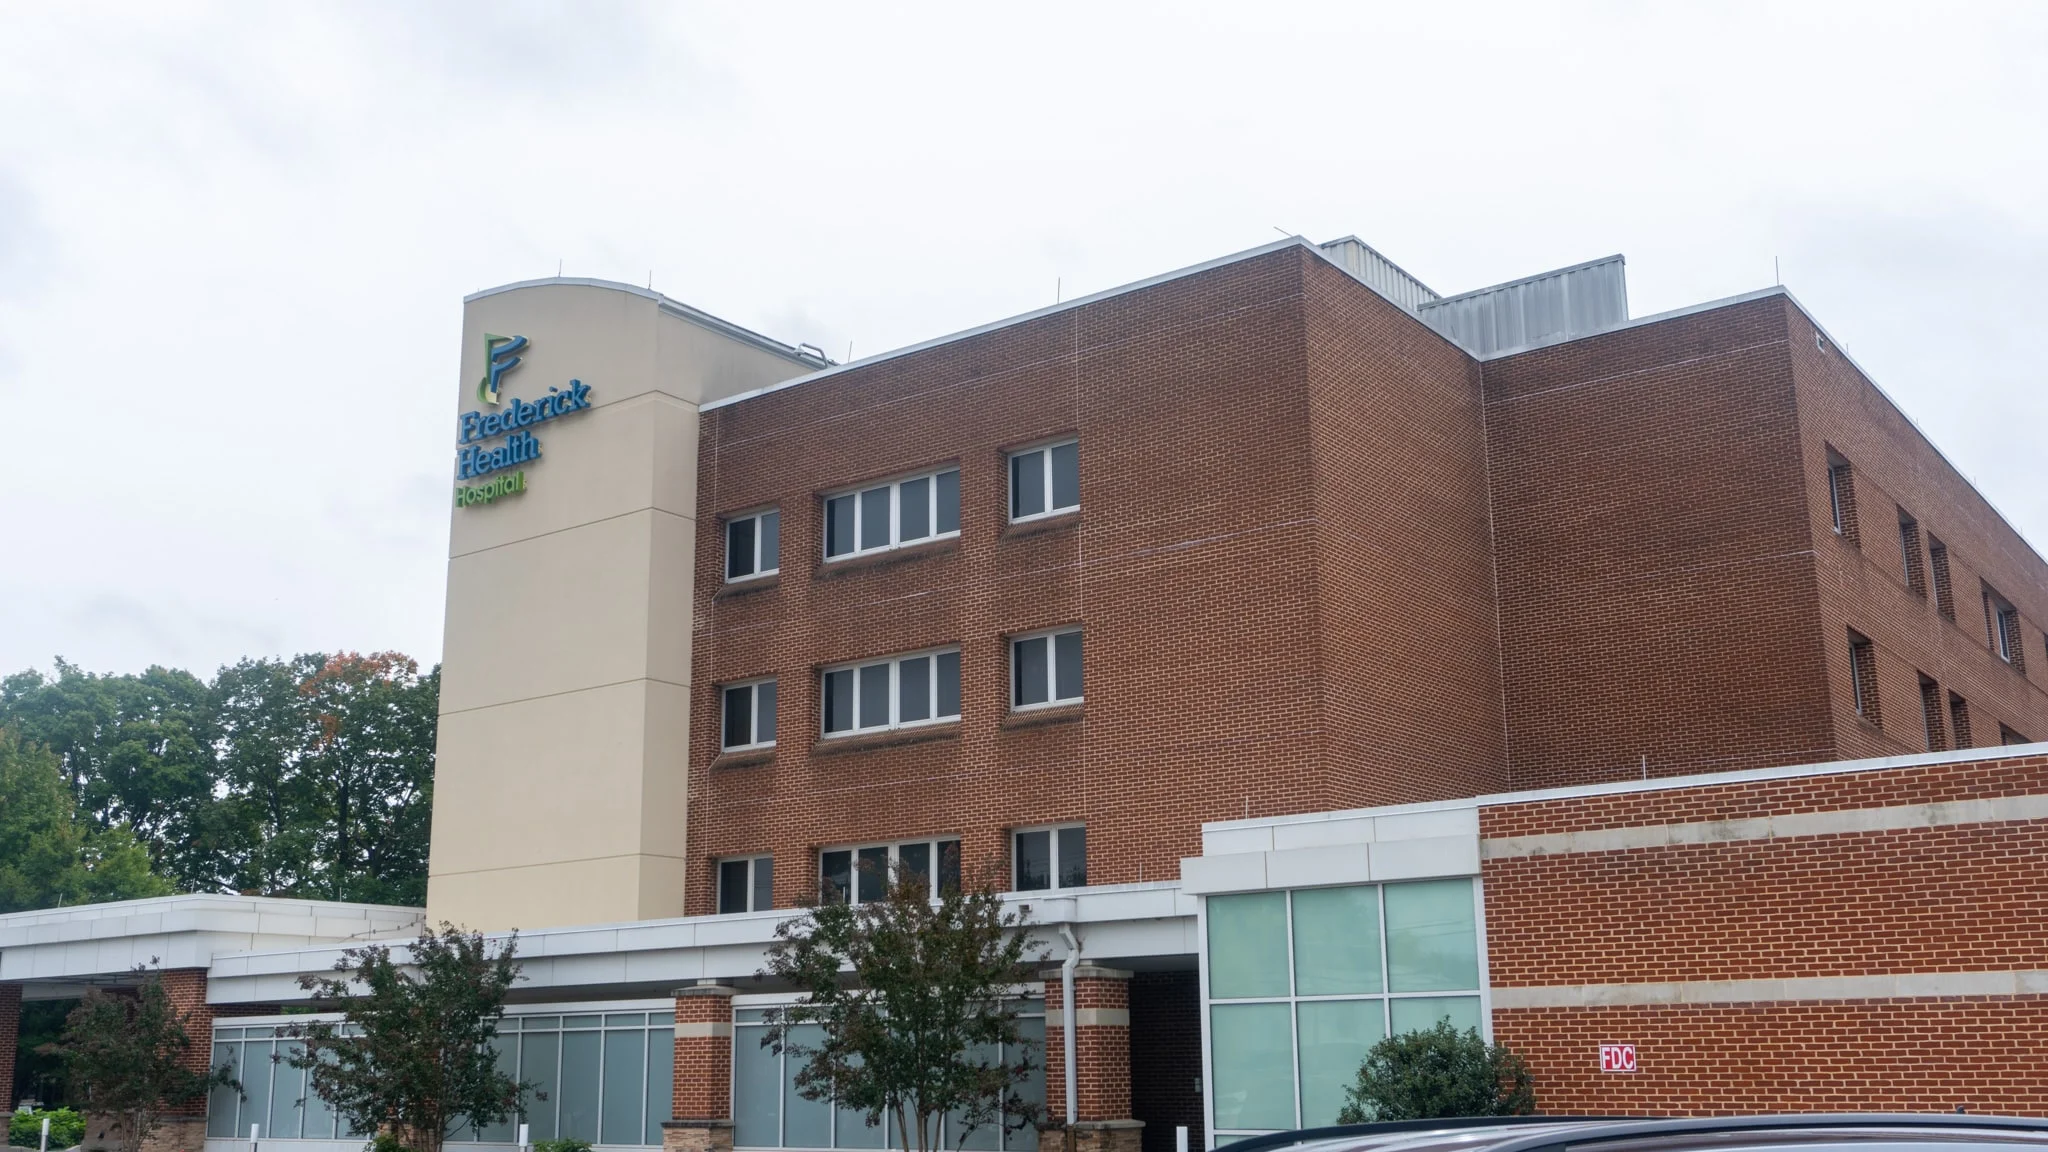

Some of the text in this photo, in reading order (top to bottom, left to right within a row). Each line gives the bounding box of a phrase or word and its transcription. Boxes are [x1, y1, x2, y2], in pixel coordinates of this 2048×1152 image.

[458, 379, 592, 445] Frederick
[456, 430, 542, 481] Health
[455, 471, 524, 508] Hospital
[1601, 1046, 1634, 1069] FDC
